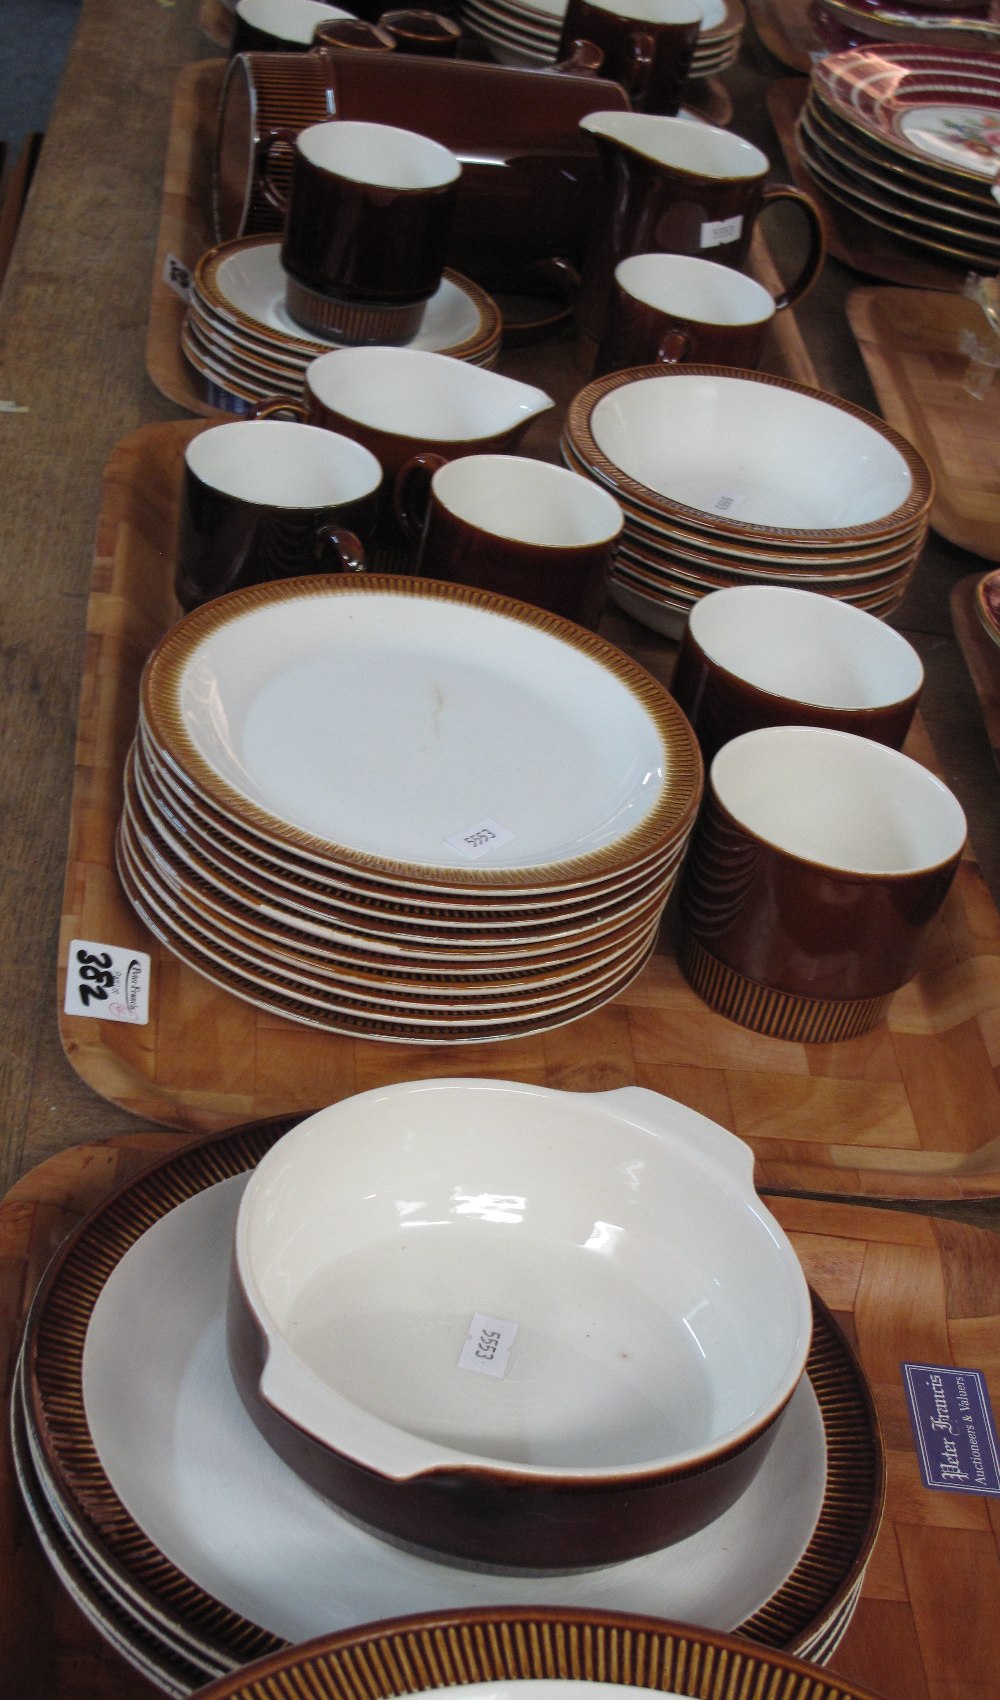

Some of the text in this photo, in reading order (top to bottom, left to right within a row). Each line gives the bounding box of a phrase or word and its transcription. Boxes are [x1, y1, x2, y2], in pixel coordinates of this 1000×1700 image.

[463, 828, 497, 848] 5553
[76, 949, 115, 1007] 382
[475, 1329, 501, 1360] 5553
[926, 1374, 970, 1482] Peter Francis
[956, 1376, 987, 1486] Auctioneers & Valuers
